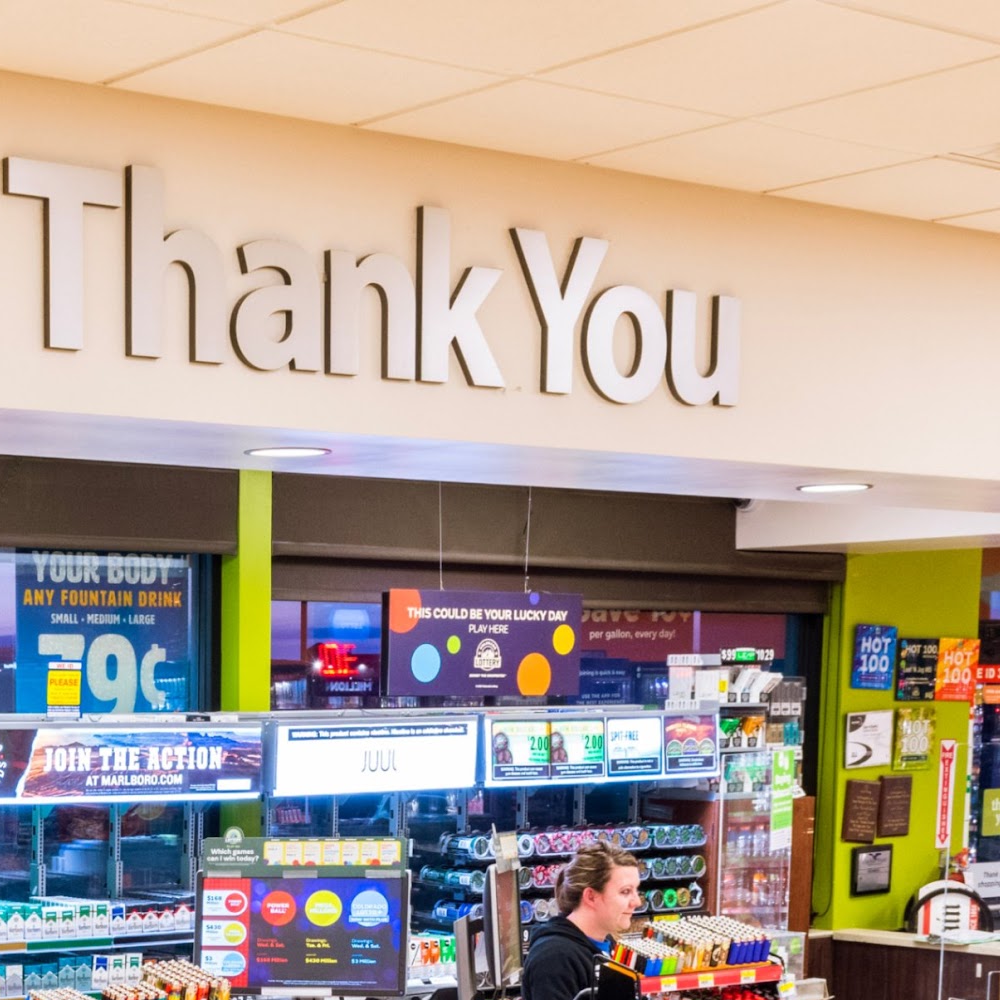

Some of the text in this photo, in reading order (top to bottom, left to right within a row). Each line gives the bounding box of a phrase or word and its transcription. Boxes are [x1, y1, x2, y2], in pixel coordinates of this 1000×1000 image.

[2, 155, 741, 407] Thank You
[31, 550, 173, 585] YOUR BODY
[23, 589, 182, 608] ANY FOUNTAIN DRINK
[50, 613, 155, 625] SMALL MEDIUM LARGE
[407, 607, 568, 622] THIS COULD BE YOUR LUCKY DAY
[468, 624, 509, 635] PLAY HERE
[589, 629, 676, 641] per gallon, every day!
[860, 637, 891, 653] HOT
[904, 644, 937, 654] HOT 100
[475, 658, 501, 667] LOTTERY
[860, 655, 889, 672] 100
[944, 651, 973, 665] HOT
[49, 678, 78, 687] PLEASE
[943, 667, 971, 684] 100
[902, 719, 930, 735] HOT
[901, 737, 929, 753] 100
[43, 746, 223, 772] JOIN THE ACTION
[361, 750, 397, 772] JUUL
[85, 774, 183, 786] AT MARLBORO.COM
[232, 848, 254, 857] games
[236, 855, 259, 863] today?
